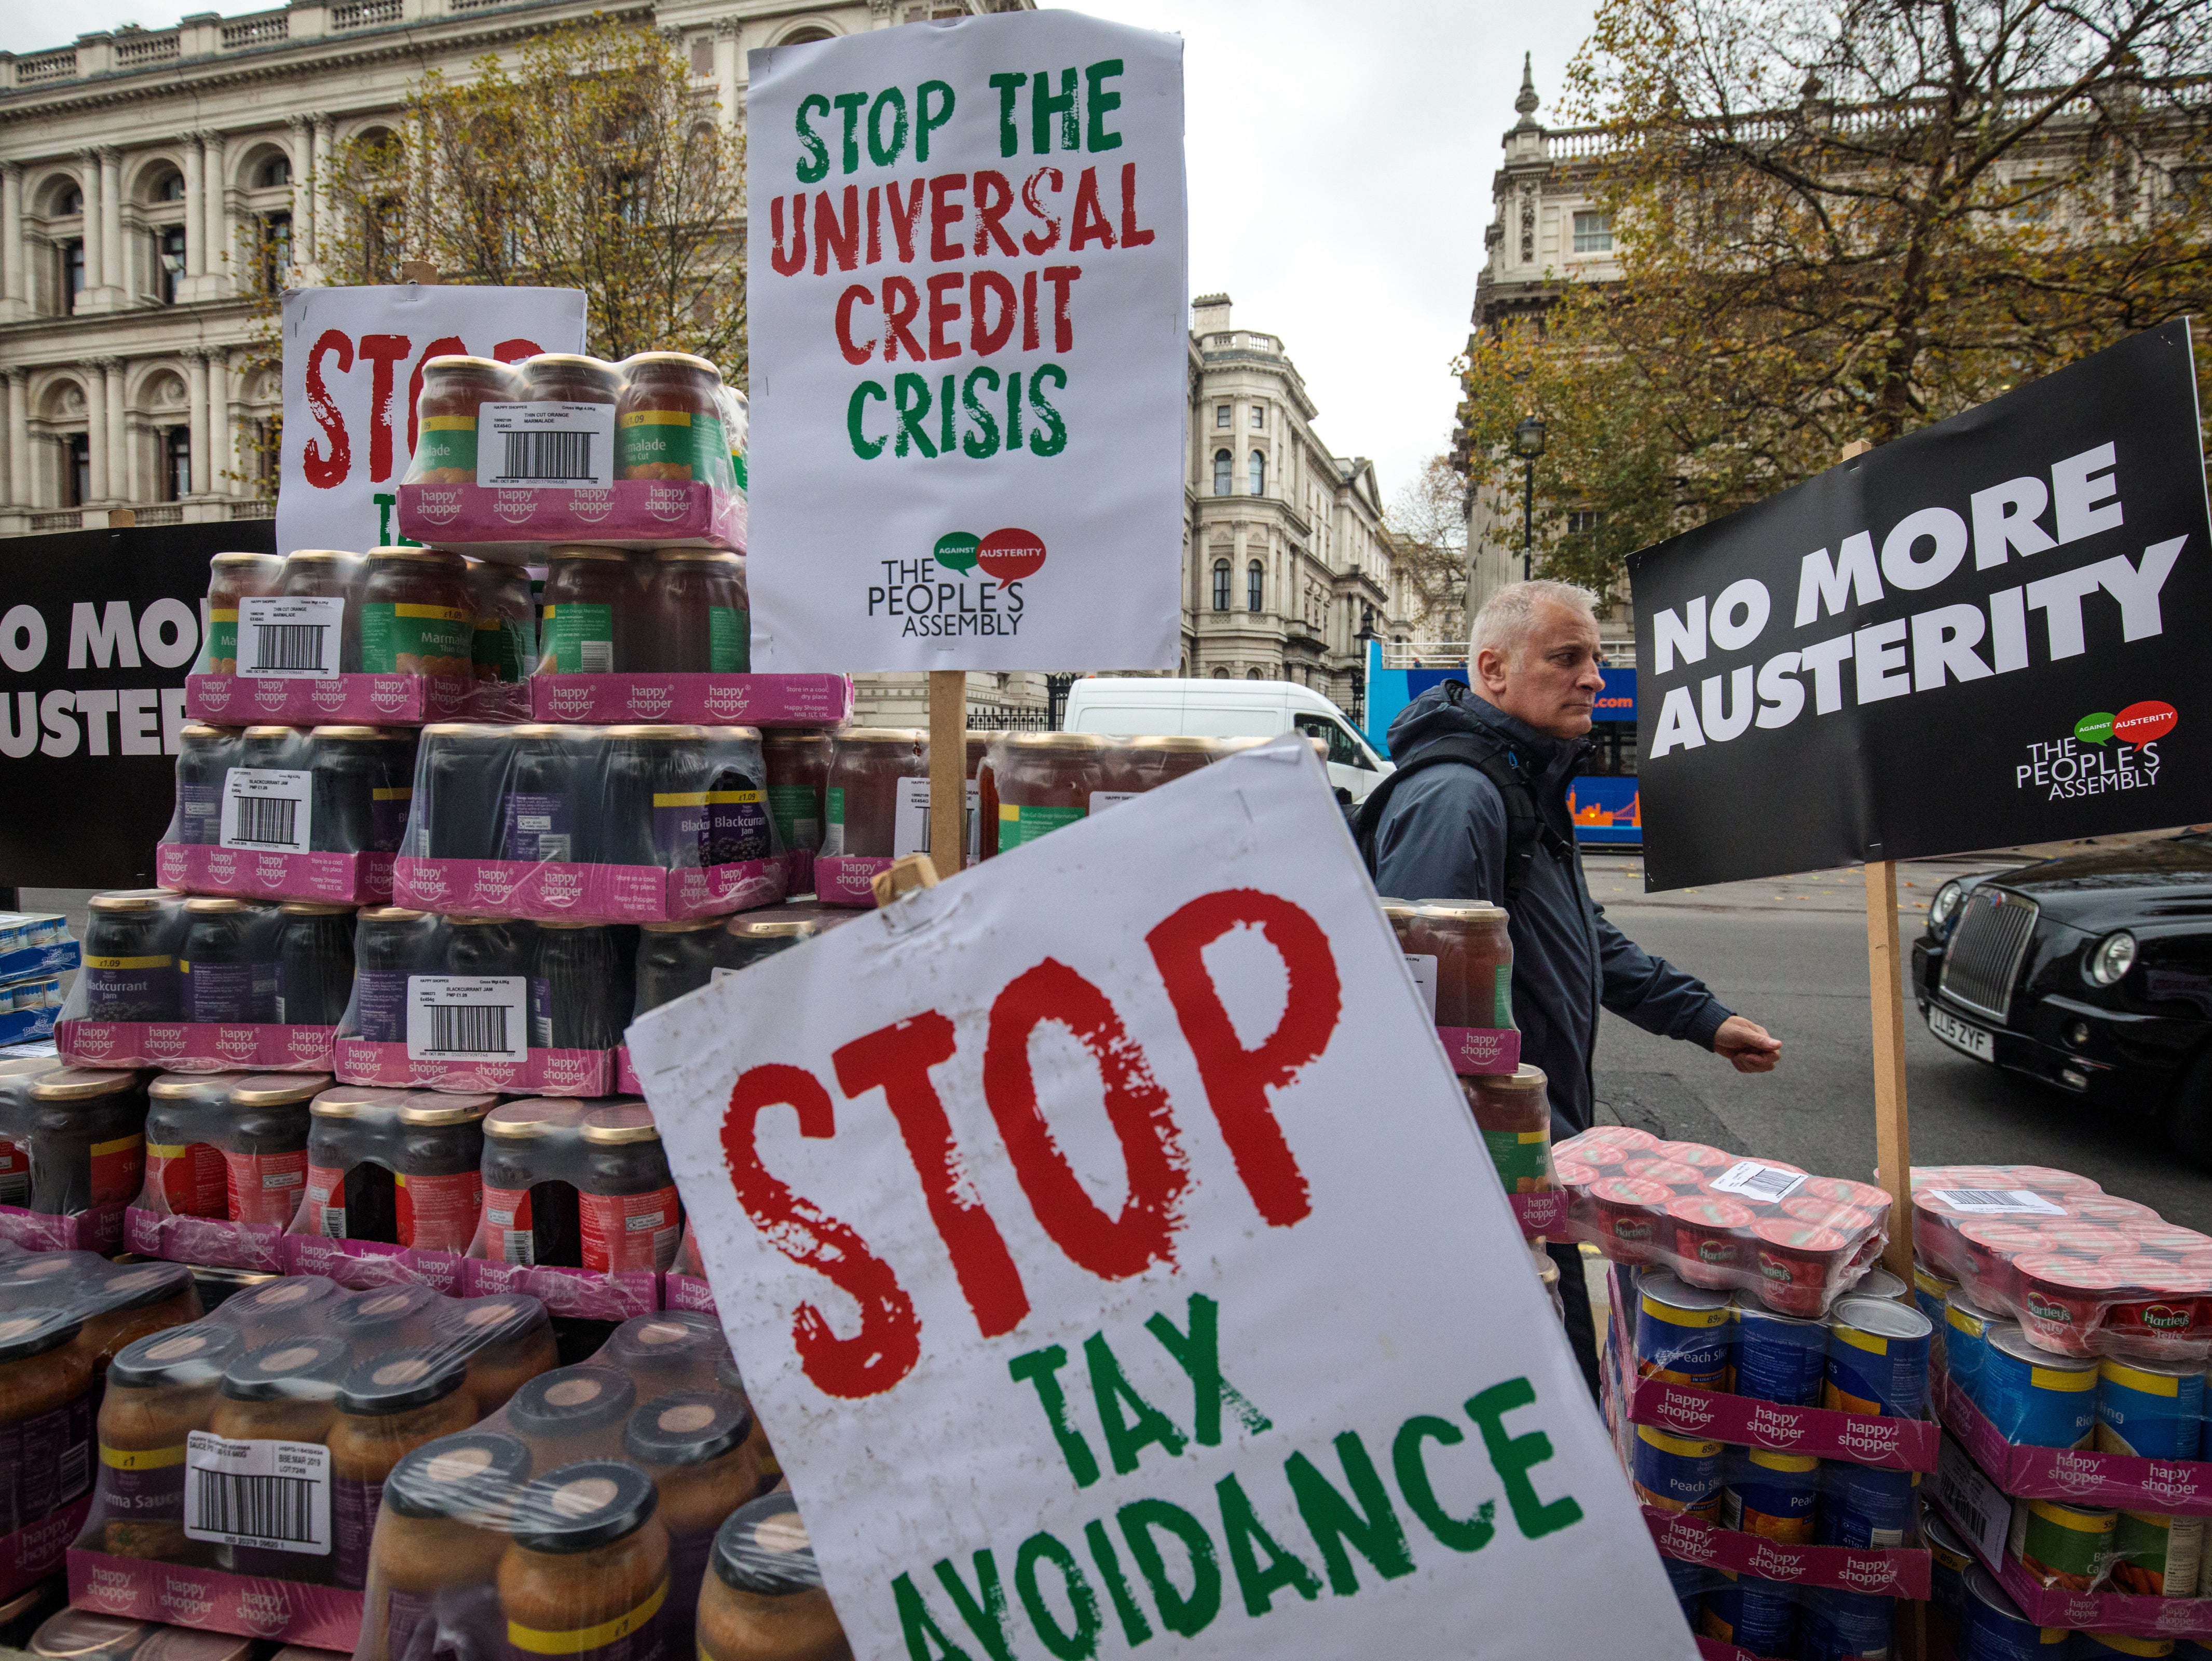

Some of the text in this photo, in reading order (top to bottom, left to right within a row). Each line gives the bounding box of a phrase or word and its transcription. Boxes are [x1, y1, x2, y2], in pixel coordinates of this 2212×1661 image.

[796, 59, 1124, 184] STOP THE
[771, 162, 1155, 277] UNIVERSAL
[836, 266, 1082, 365] CREDIT
[847, 364, 1067, 460] CRISIS
[421, 490, 456, 504] happy
[498, 488, 532, 502] happy
[650, 486, 686, 500] happy
[417, 503, 462, 514] shopper
[494, 501, 538, 513] shopper
[569, 500, 613, 512] shopper
[645, 500, 691, 513] shopper
[980, 548, 1042, 557] AUSTERITY
[1653, 441, 2123, 676] NO MORE
[882, 558, 934, 584] THE
[903, 614, 1023, 637] ASSEMBLY
[0, 598, 208, 672] O MO
[1650, 534, 2189, 759] AUSTERITY
[201, 679, 227, 693] happy
[315, 679, 343, 692] happy
[374, 678, 403, 693] happy
[632, 685, 666, 699] happy
[709, 685, 744, 699] happy
[199, 691, 231, 703] shopper
[255, 692, 288, 703] shopper
[312, 691, 346, 703] shopper
[371, 692, 409, 704] shopper
[553, 686, 589, 700] happy
[548, 699, 594, 712] shopper
[627, 698, 672, 711] shopper
[704, 698, 749, 711] shopper
[2079, 712, 2173, 732] AGAINST AUSTERITY
[2027, 737, 2077, 763] THE
[2049, 767, 2160, 800] ASSEMBLY
[165, 849, 183, 863] happy
[211, 851, 232, 864] happy
[260, 854, 283, 867] happy
[162, 862, 187, 874] shopper
[208, 865, 236, 876] shopper
[256, 867, 287, 878] shopper
[413, 865, 442, 882] happy
[721, 867, 742, 880] happy
[842, 861, 876, 873] happy
[478, 867, 508, 885] happy
[545, 870, 577, 886] happy
[409, 879, 445, 892] shopper
[474, 881, 513, 895] shopper
[540, 883, 582, 897] shopper
[78, 1026, 109, 1040] happy
[149, 1026, 181, 1040] happy
[221, 1028, 253, 1041] happy
[292, 1029, 324, 1043] happy
[1466, 1032, 1498, 1048] happy
[74, 1038, 114, 1050] shopper
[145, 1038, 186, 1050] shopper
[216, 1040, 258, 1052] shopper
[288, 1041, 330, 1053] shopper
[349, 1046, 376, 1062] happy
[1461, 1044, 1502, 1059] shopper
[345, 1060, 381, 1073] shopper
[409, 1061, 448, 1075] shopper
[548, 1055, 580, 1070] happy
[475, 1065, 515, 1078] shopper
[543, 1067, 584, 1082] shopper
[719, 886, 1342, 1400] STOP
[1528, 1197, 1554, 1211] happy
[1523, 1208, 1557, 1222] shopper
[296, 1256, 335, 1271] shopper
[418, 1257, 449, 1272] happy
[2028, 1298, 2070, 1320] Hartley's
[2145, 1313, 2189, 1327] Hartley's
[1008, 1292, 1273, 1489] TAX
[1665, 1389, 1709, 1411] happy
[1658, 1402, 1714, 1424] shopper
[1756, 1406, 1799, 1427] happy
[1747, 1420, 1805, 1440] shopper
[1847, 1419, 1893, 1439] happy
[1838, 1433, 1899, 1452] shopper
[2057, 1453, 2100, 1473] happy
[2048, 1467, 2106, 1486] shopper
[2150, 1463, 2191, 1482] happy
[1671, 1479, 1704, 1492] Peach
[2142, 1478, 2198, 1497] shopper
[887, 1376, 1585, 1661] AVOIDANCE
[1661, 1533, 1716, 1558] shopper
[1758, 1545, 1800, 1565] happy
[1749, 1556, 1805, 1575] shopper
[1847, 1557, 1890, 1577] happy
[92, 1565, 131, 1586] happy
[87, 1584, 138, 1601] shopper
[166, 1576, 206, 1600] happy
[161, 1594, 213, 1613] shopper
[2070, 1598, 2096, 1610] happy
[237, 1606, 290, 1626] shopper
[2064, 1608, 2097, 1618] shopper
